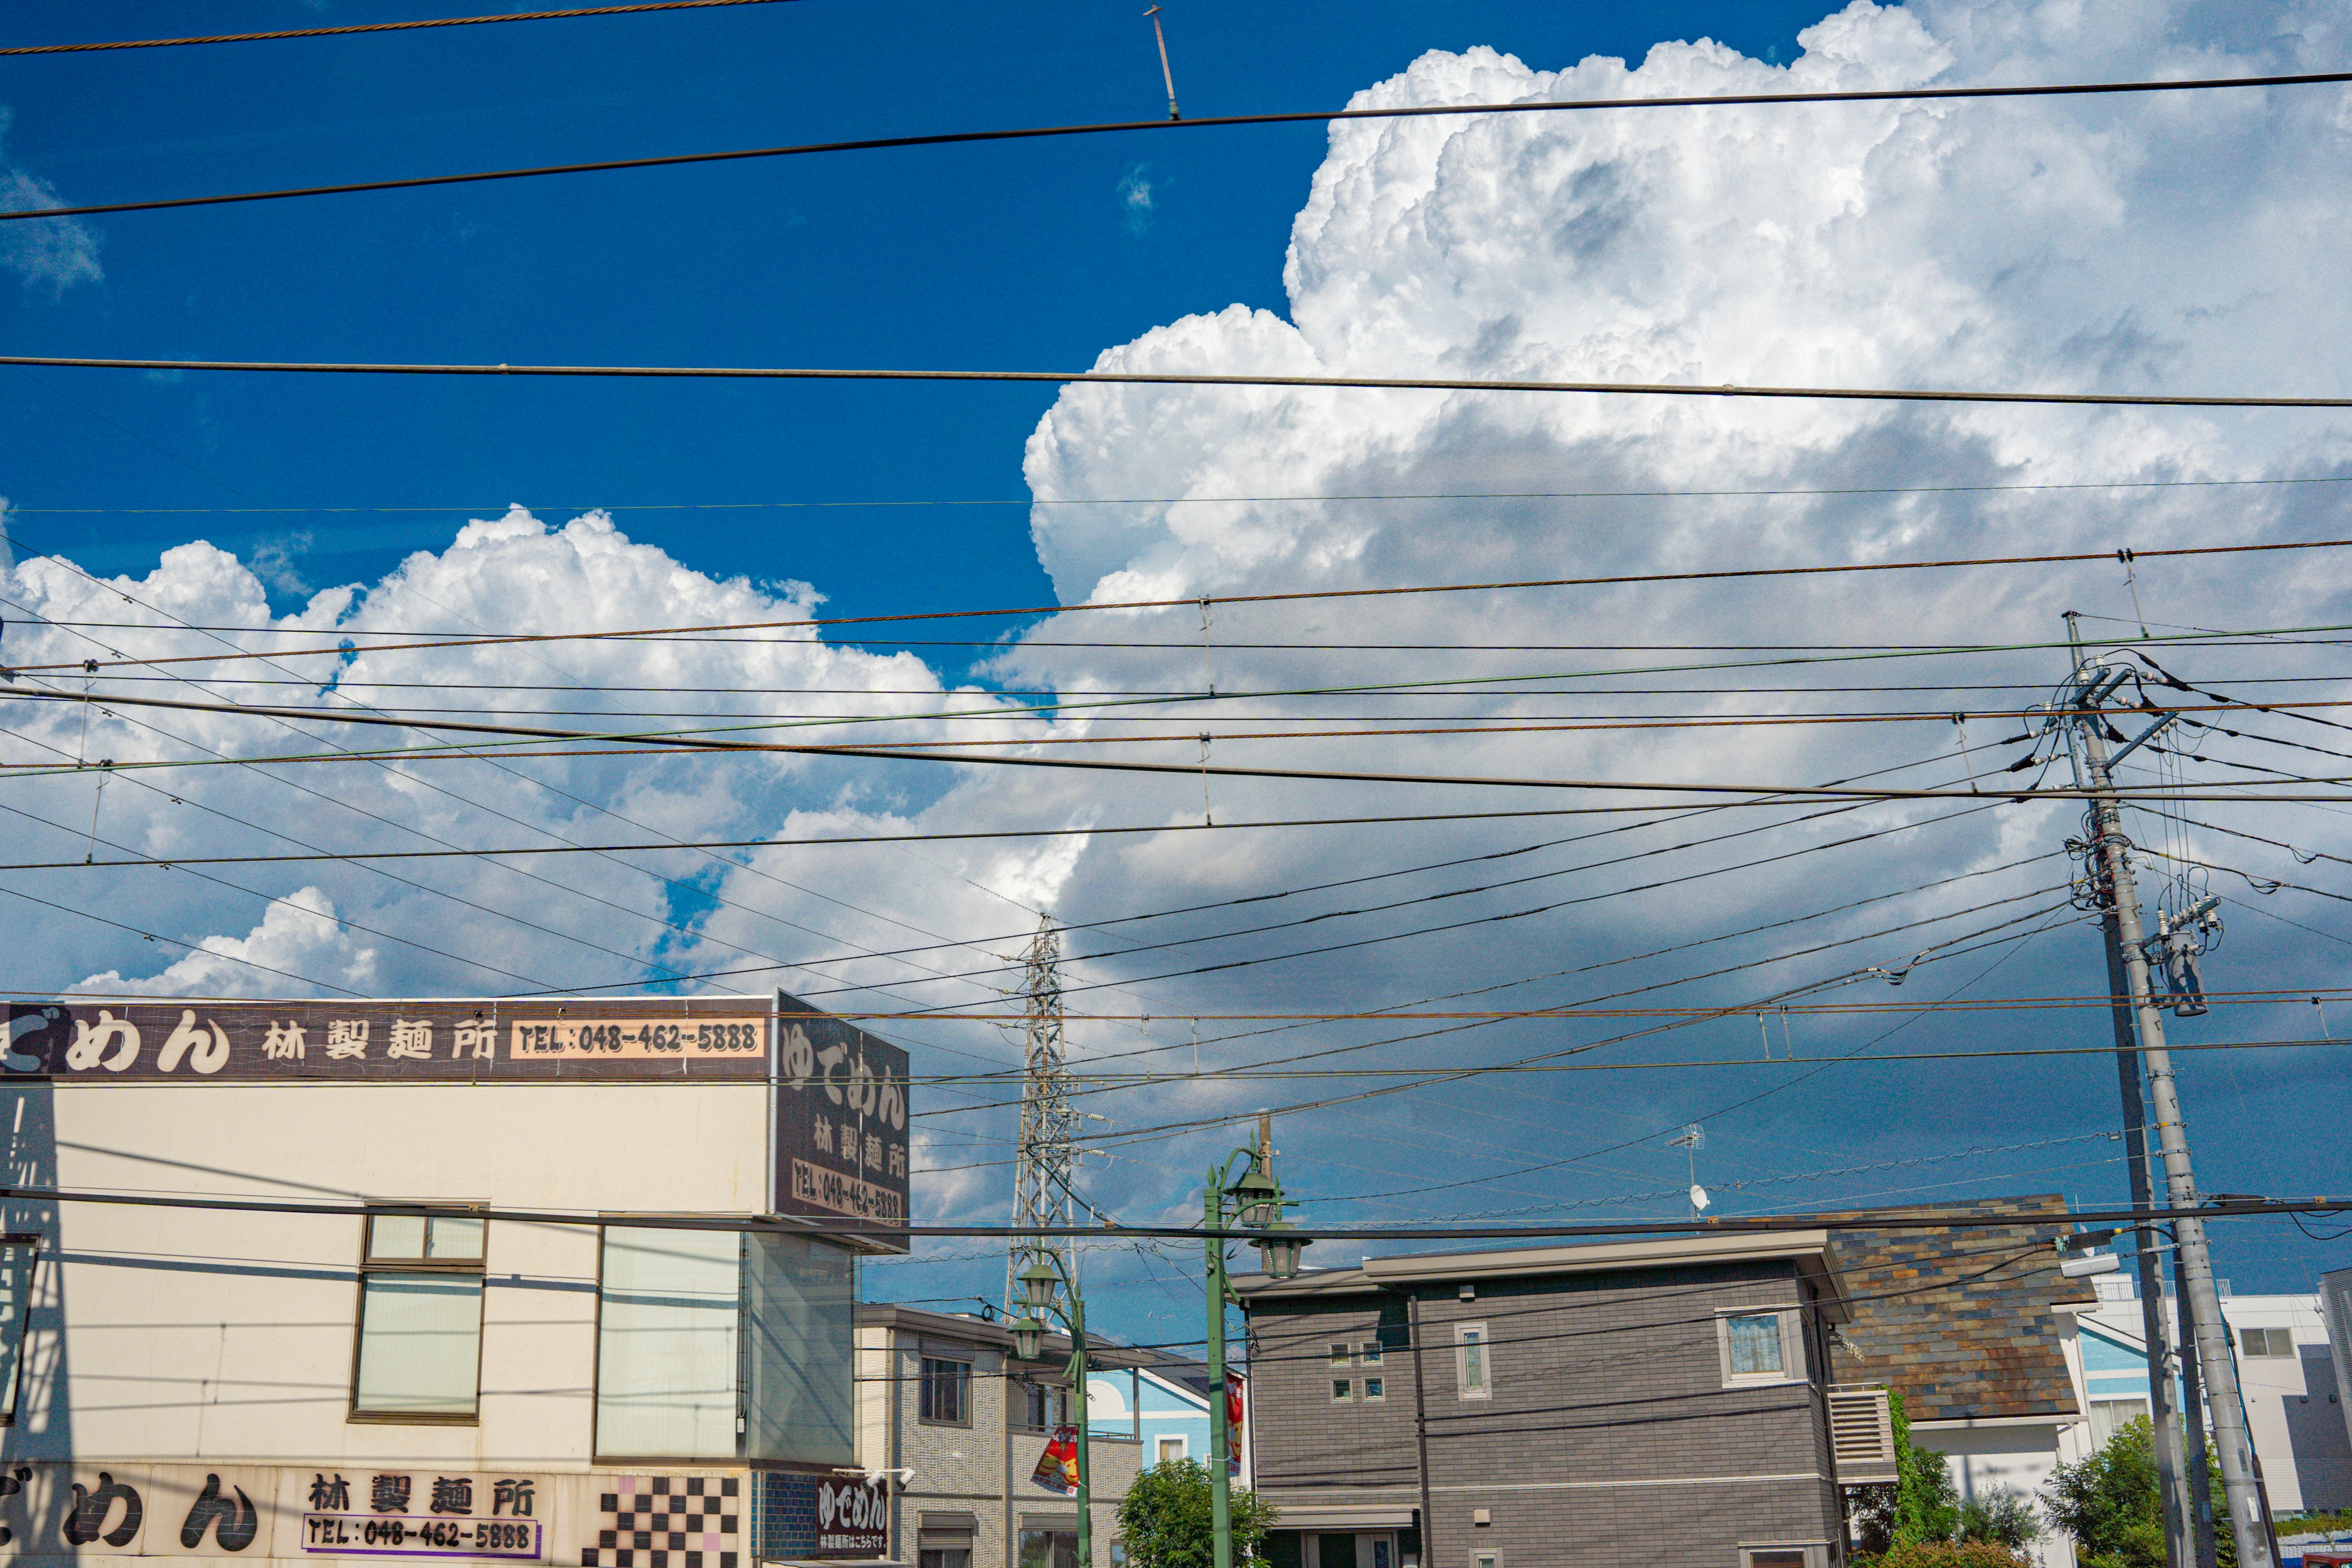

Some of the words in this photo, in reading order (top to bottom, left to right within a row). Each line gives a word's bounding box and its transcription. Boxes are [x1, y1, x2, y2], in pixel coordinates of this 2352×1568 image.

[262, 1019, 498, 1060] 林製麺所
[783, 1023, 905, 1131] ゆでめん
[814, 1113, 905, 1180] 林製麺所
[309, 1473, 535, 1517] 林製麺所
[818, 1481, 886, 1530] ゆでめん
[820, 1534, 886, 1549] 林製麺所はこちらです。
